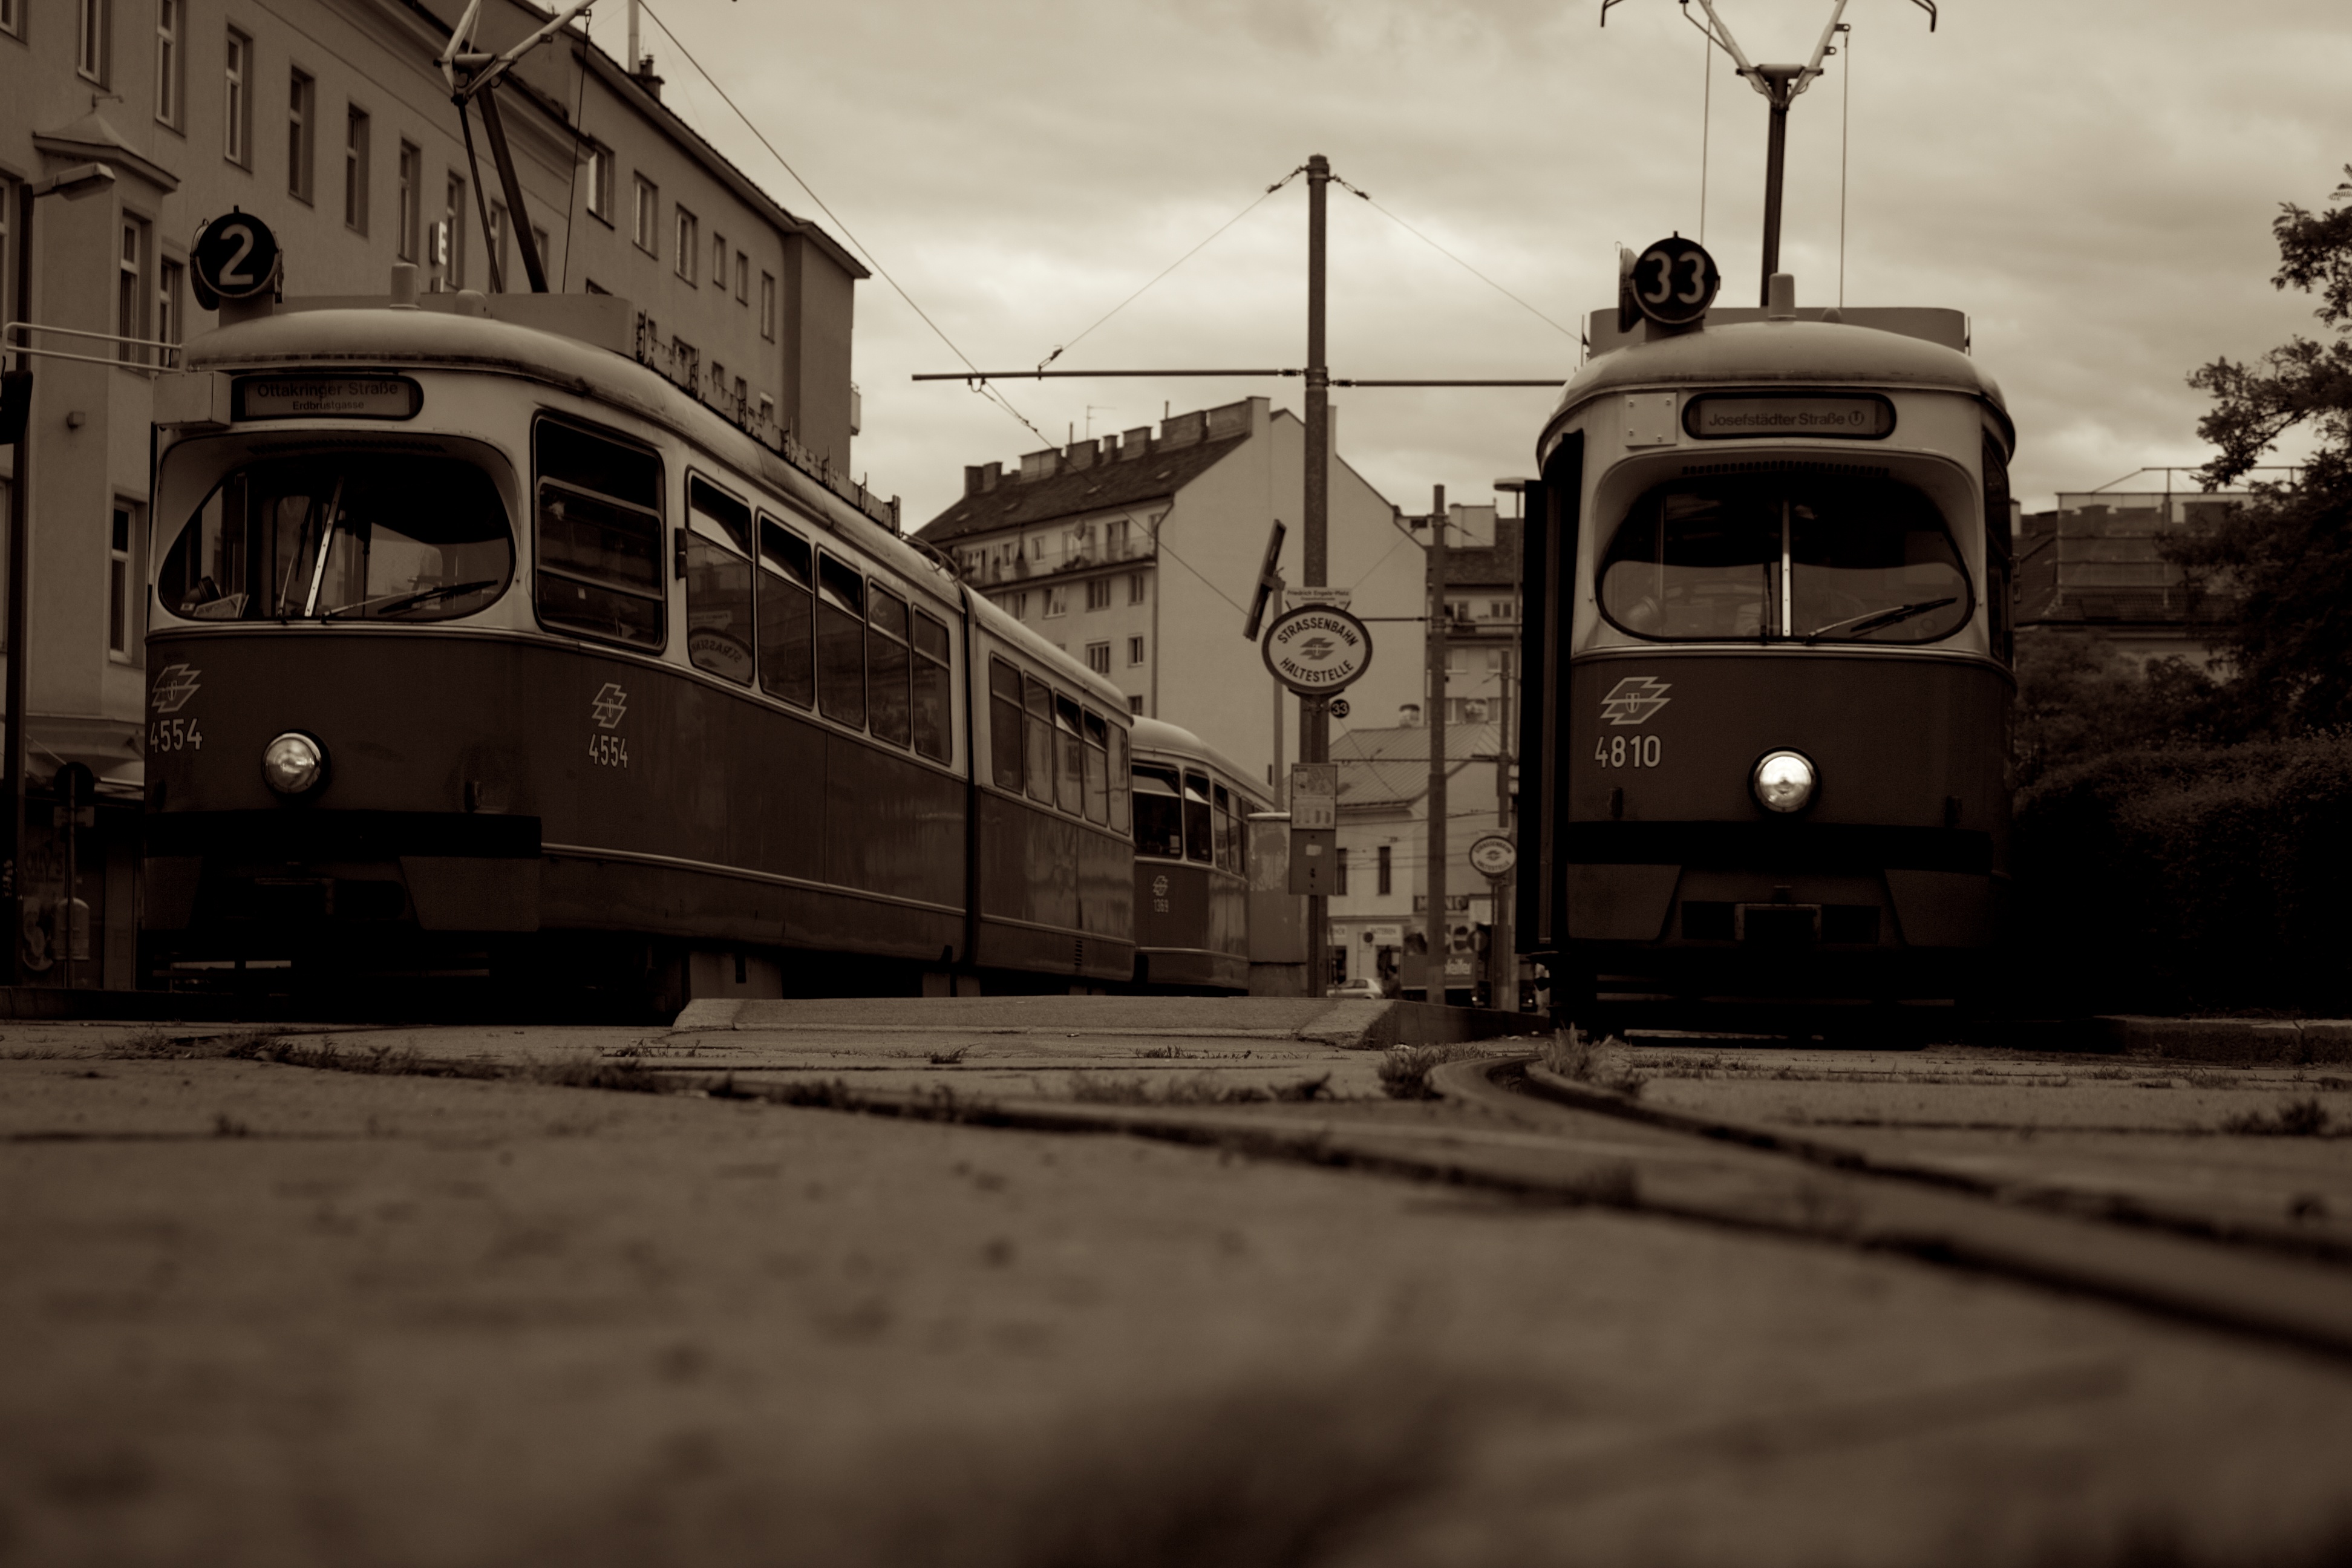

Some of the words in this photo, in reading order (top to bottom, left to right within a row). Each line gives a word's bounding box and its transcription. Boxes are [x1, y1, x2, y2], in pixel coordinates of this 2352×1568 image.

[218, 222, 255, 286] 2
[1643, 249, 1707, 305] 33
[257, 382, 343, 399] Ottakringer
[348, 381, 399, 396] Straße
[292, 400, 365, 411] Erdbrustgasse
[1709, 413, 1797, 426] Josefstädter
[1798, 412, 1846, 425] Straße
[1277, 617, 1359, 647] STRASSENBAHN
[1279, 657, 1354, 682] HALTESTELLE
[1331, 702, 1348, 715] 33
[149, 717, 203, 754] 4554
[589, 733, 629, 769] 4554
[1593, 734, 1662, 768] 4810
